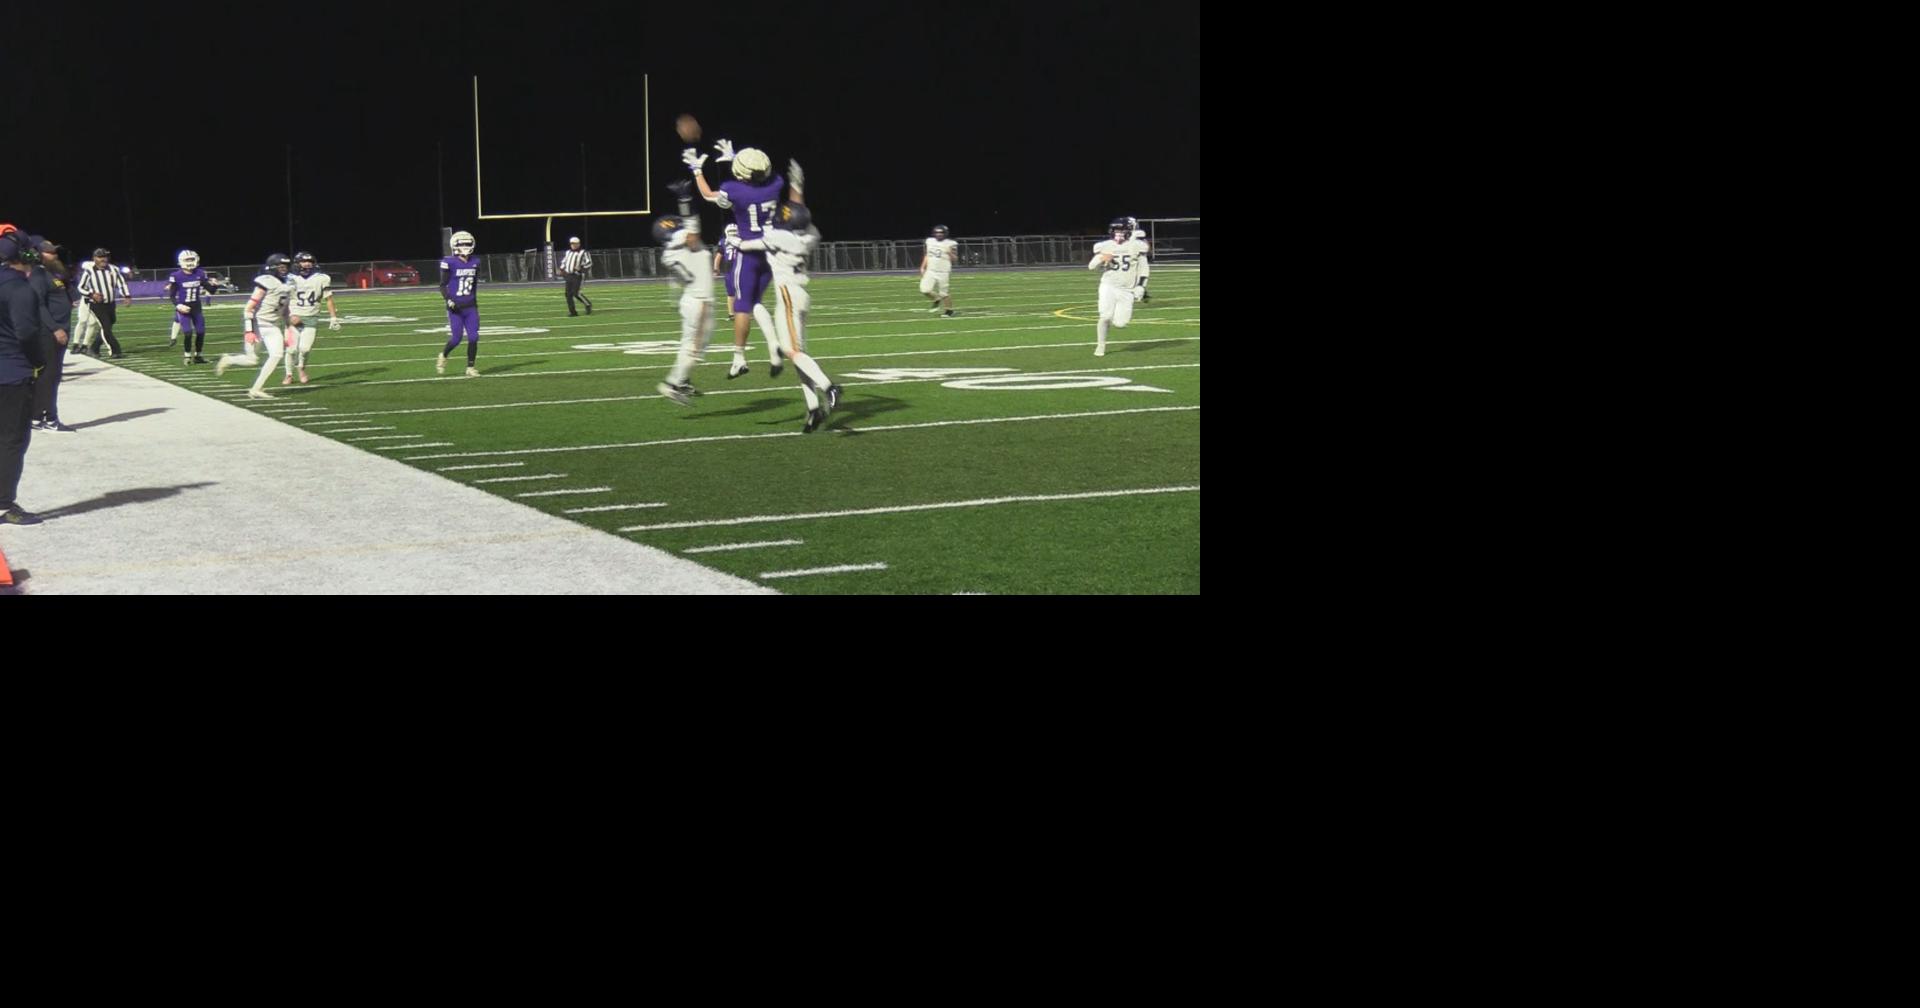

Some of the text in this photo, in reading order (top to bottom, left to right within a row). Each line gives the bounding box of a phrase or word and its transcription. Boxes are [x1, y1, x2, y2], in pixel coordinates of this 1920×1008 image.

[748, 200, 776, 231] 17
[1111, 255, 1130, 271] 55
[297, 291, 317, 306] 54
